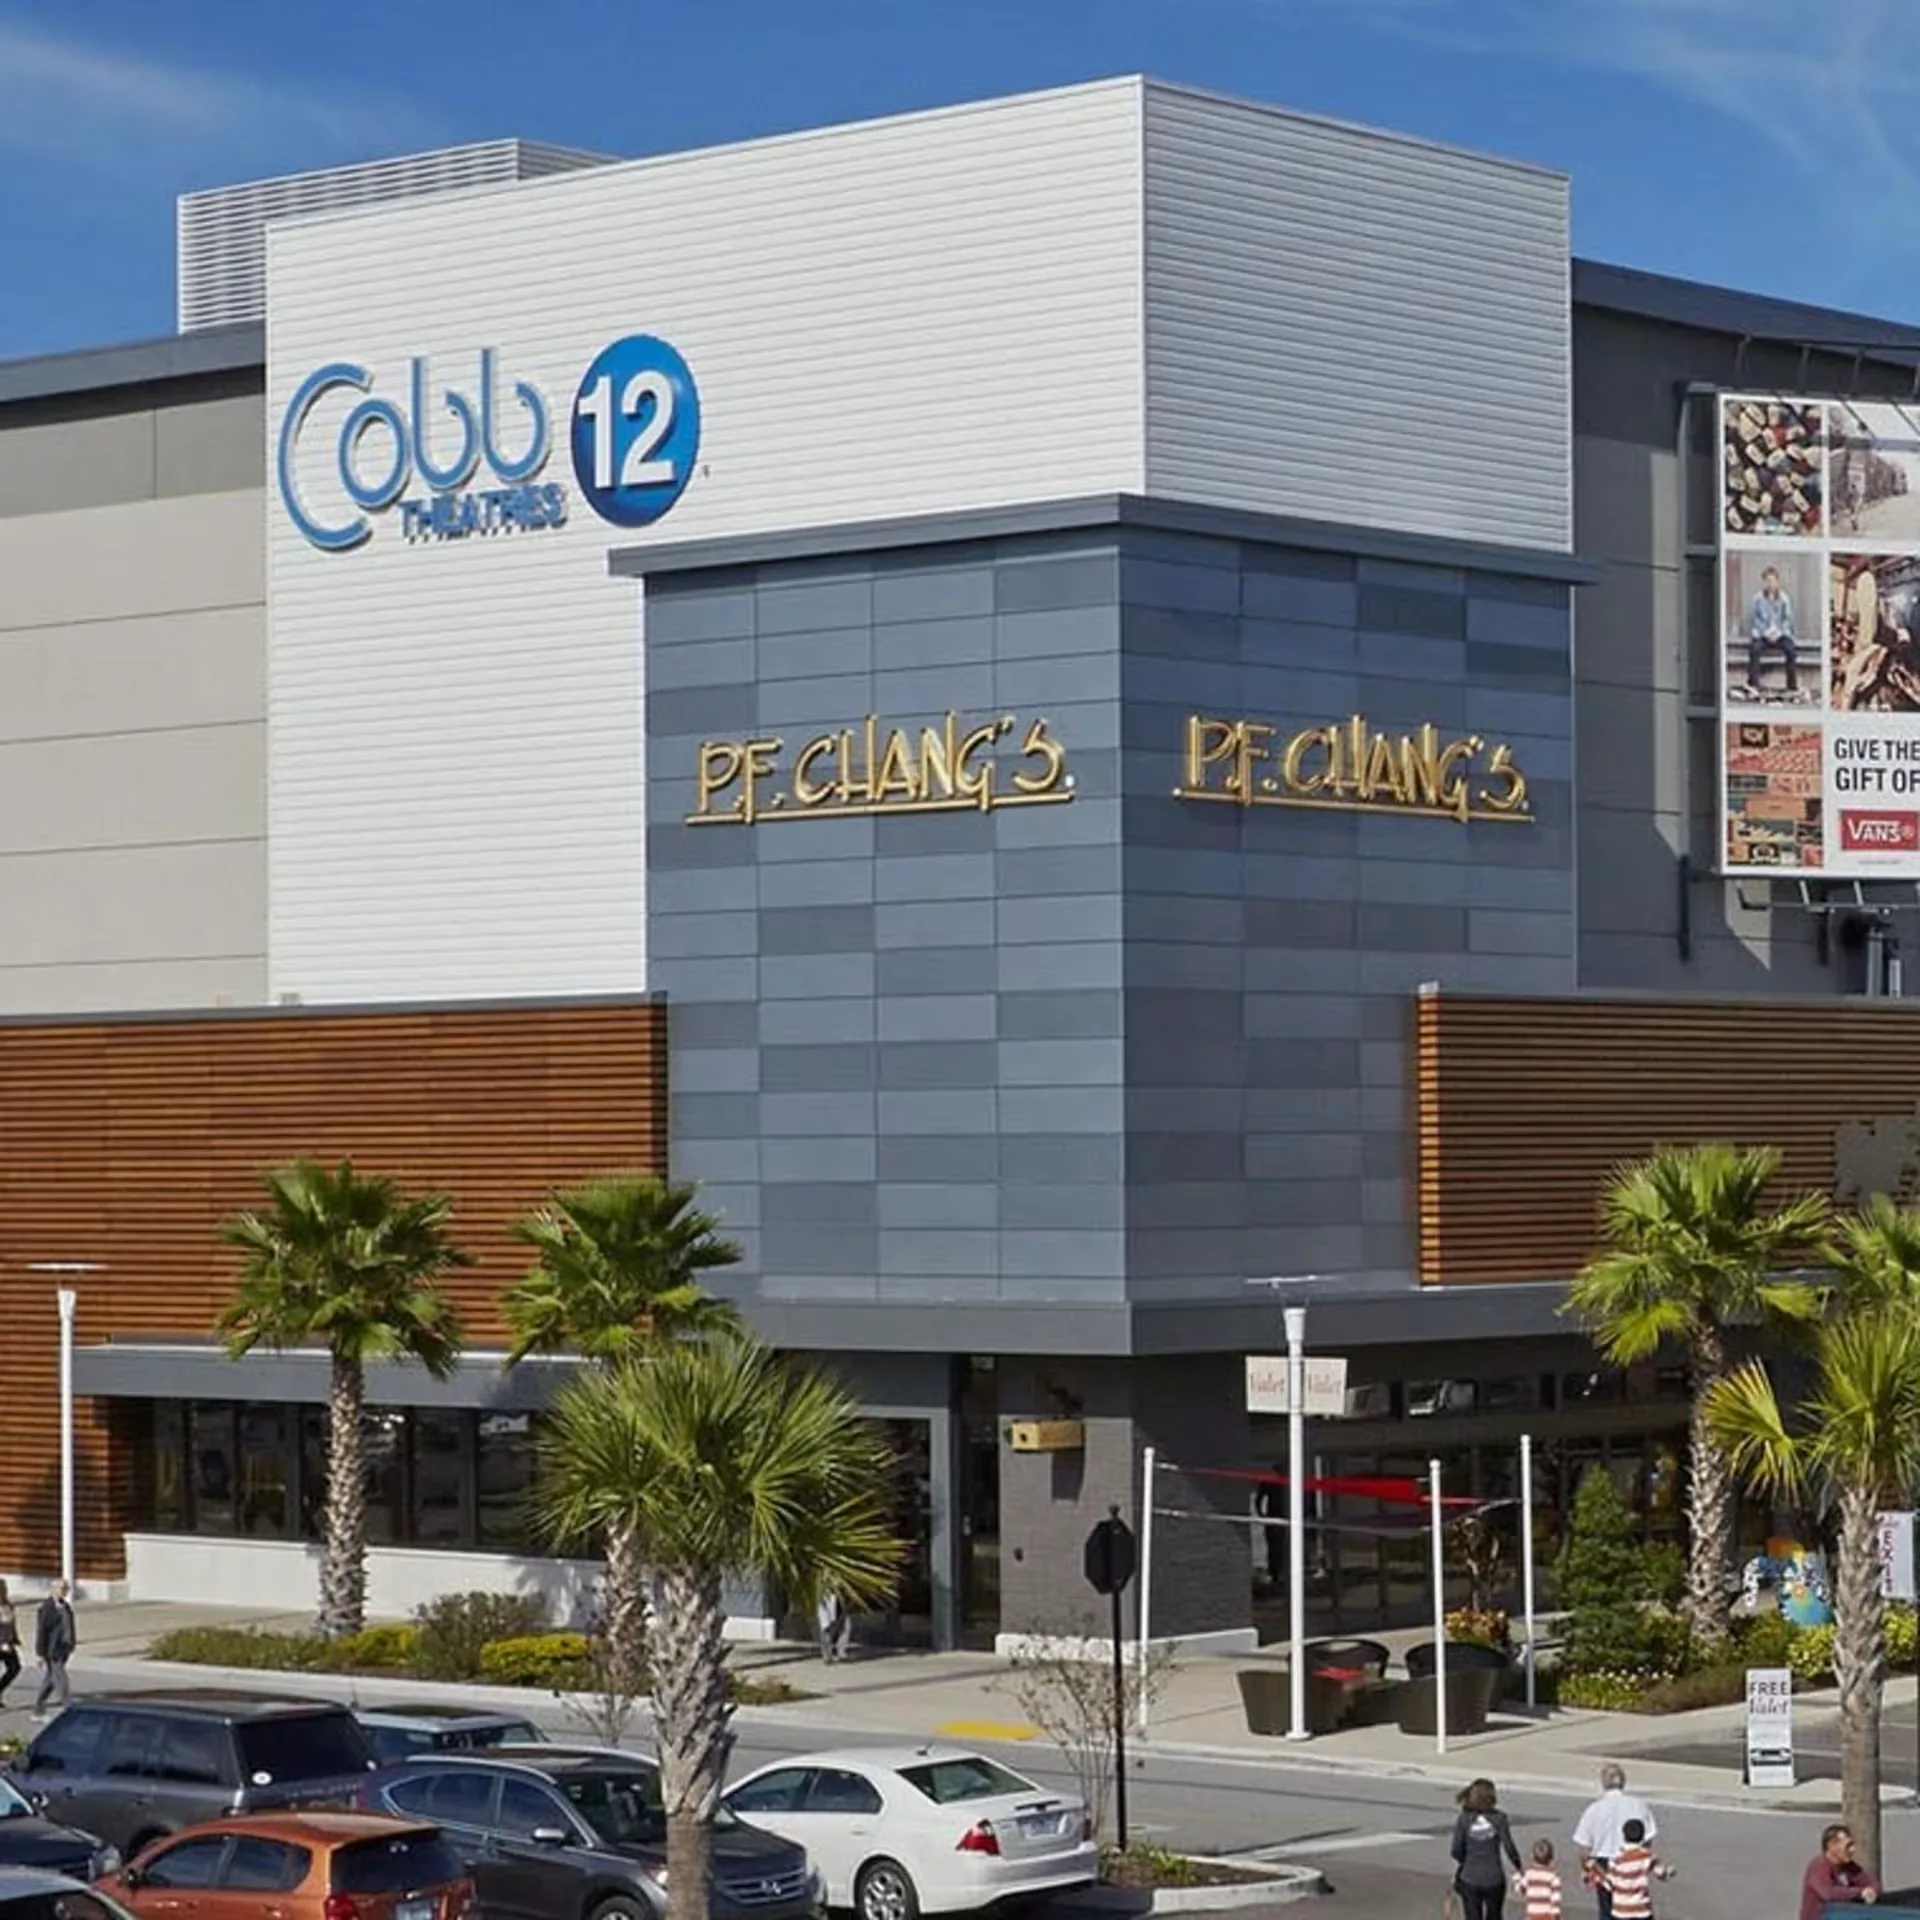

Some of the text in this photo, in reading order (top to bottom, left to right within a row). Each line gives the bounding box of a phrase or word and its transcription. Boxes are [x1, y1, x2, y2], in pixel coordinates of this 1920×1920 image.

[277, 348, 679, 553] Cobb 12
[399, 483, 568, 543] THEATRES
[1834, 737, 1920, 761] GIVE THE
[1835, 767, 1920, 793] GIFT OF
[1749, 1681, 1789, 1696] FREE
